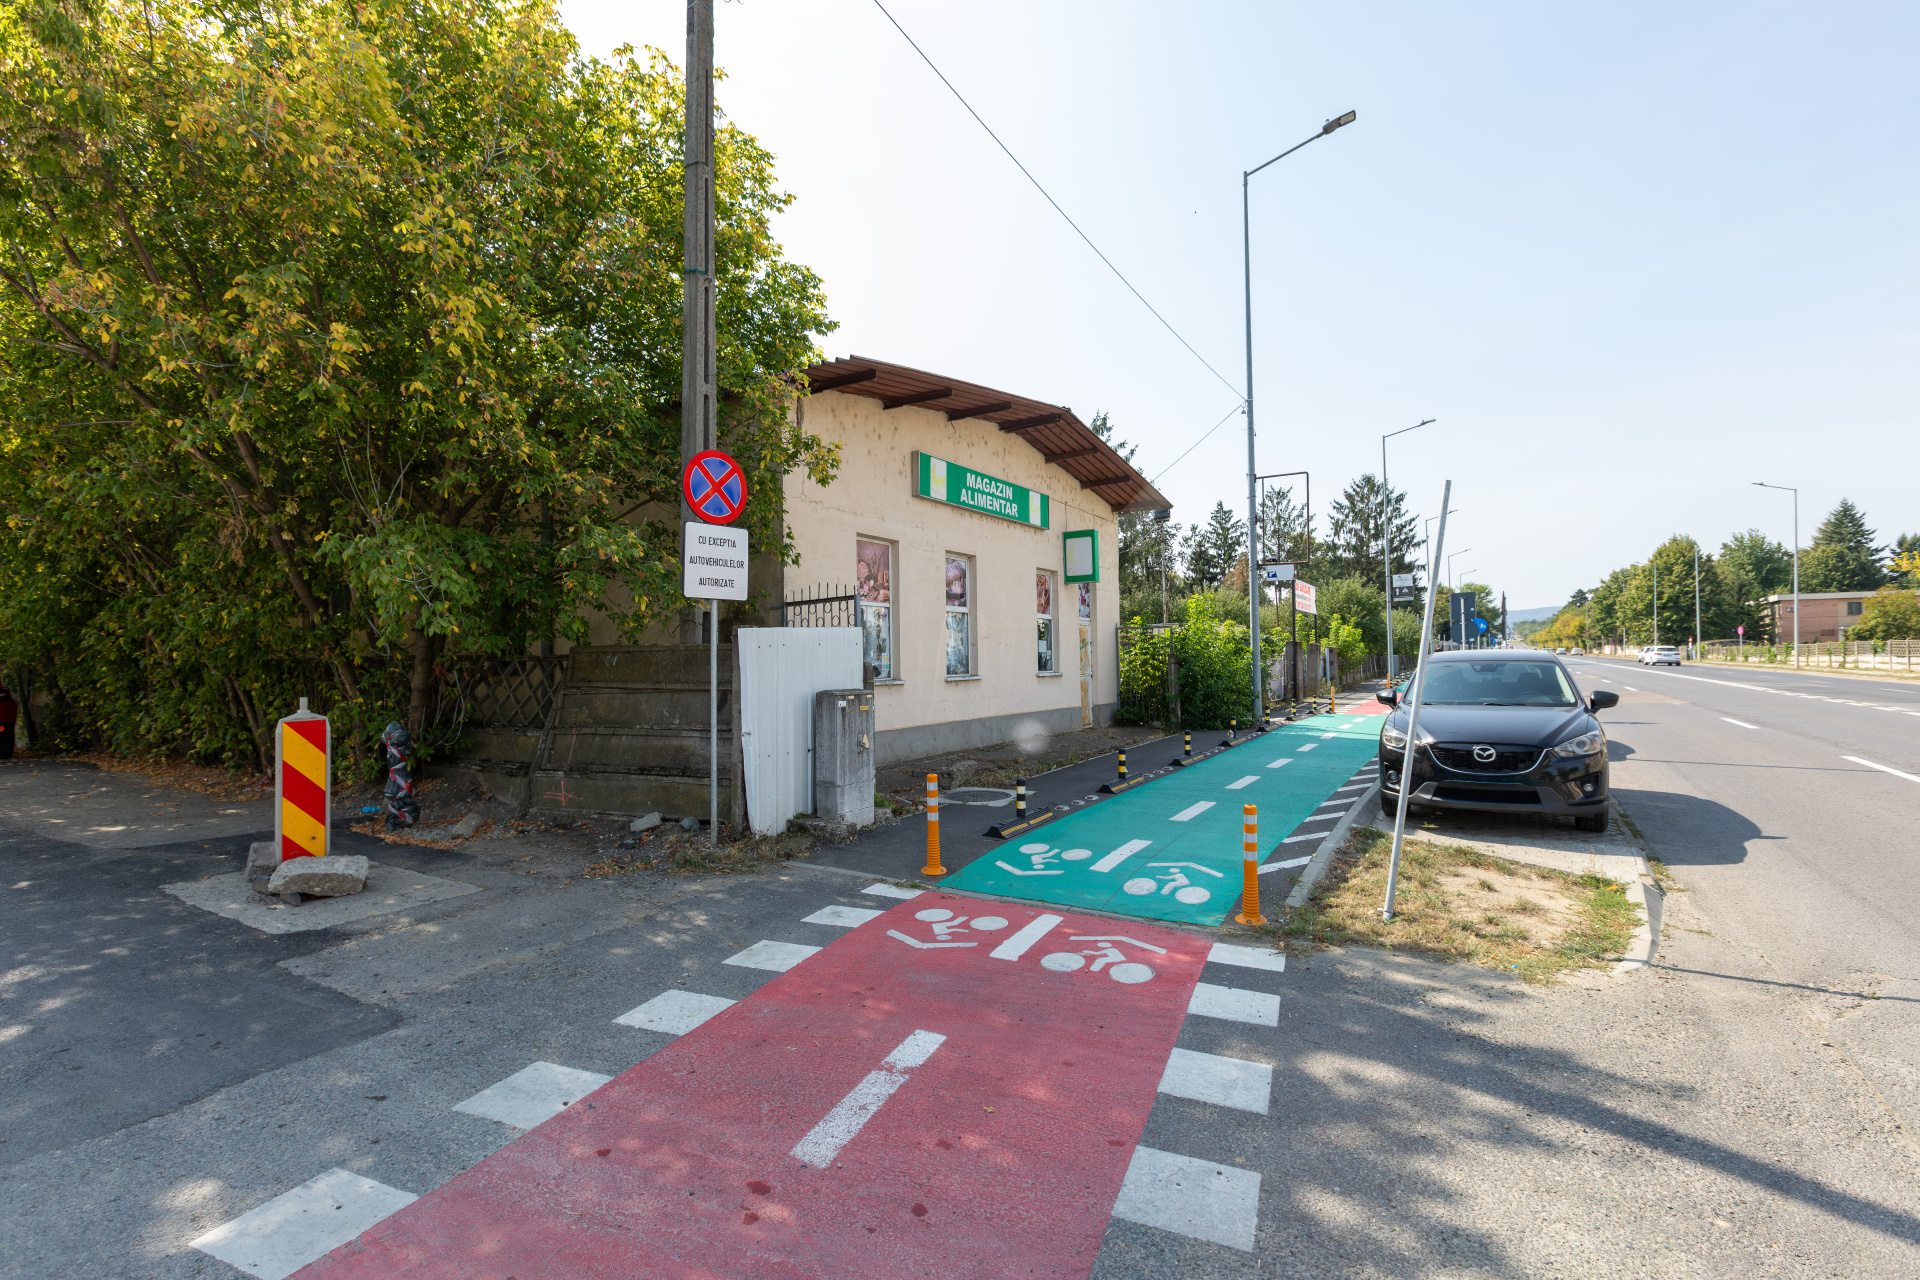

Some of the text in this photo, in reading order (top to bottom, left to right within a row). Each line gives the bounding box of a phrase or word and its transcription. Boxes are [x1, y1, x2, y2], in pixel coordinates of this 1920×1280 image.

[966, 472, 1013, 500] MAGAZIN
[960, 488, 1018, 518] ALIMENTAR
[698, 535, 707, 545] CU
[689, 555, 745, 569] AUTOVEHICULELOR
[698, 577, 735, 588] AUTORIZATE
